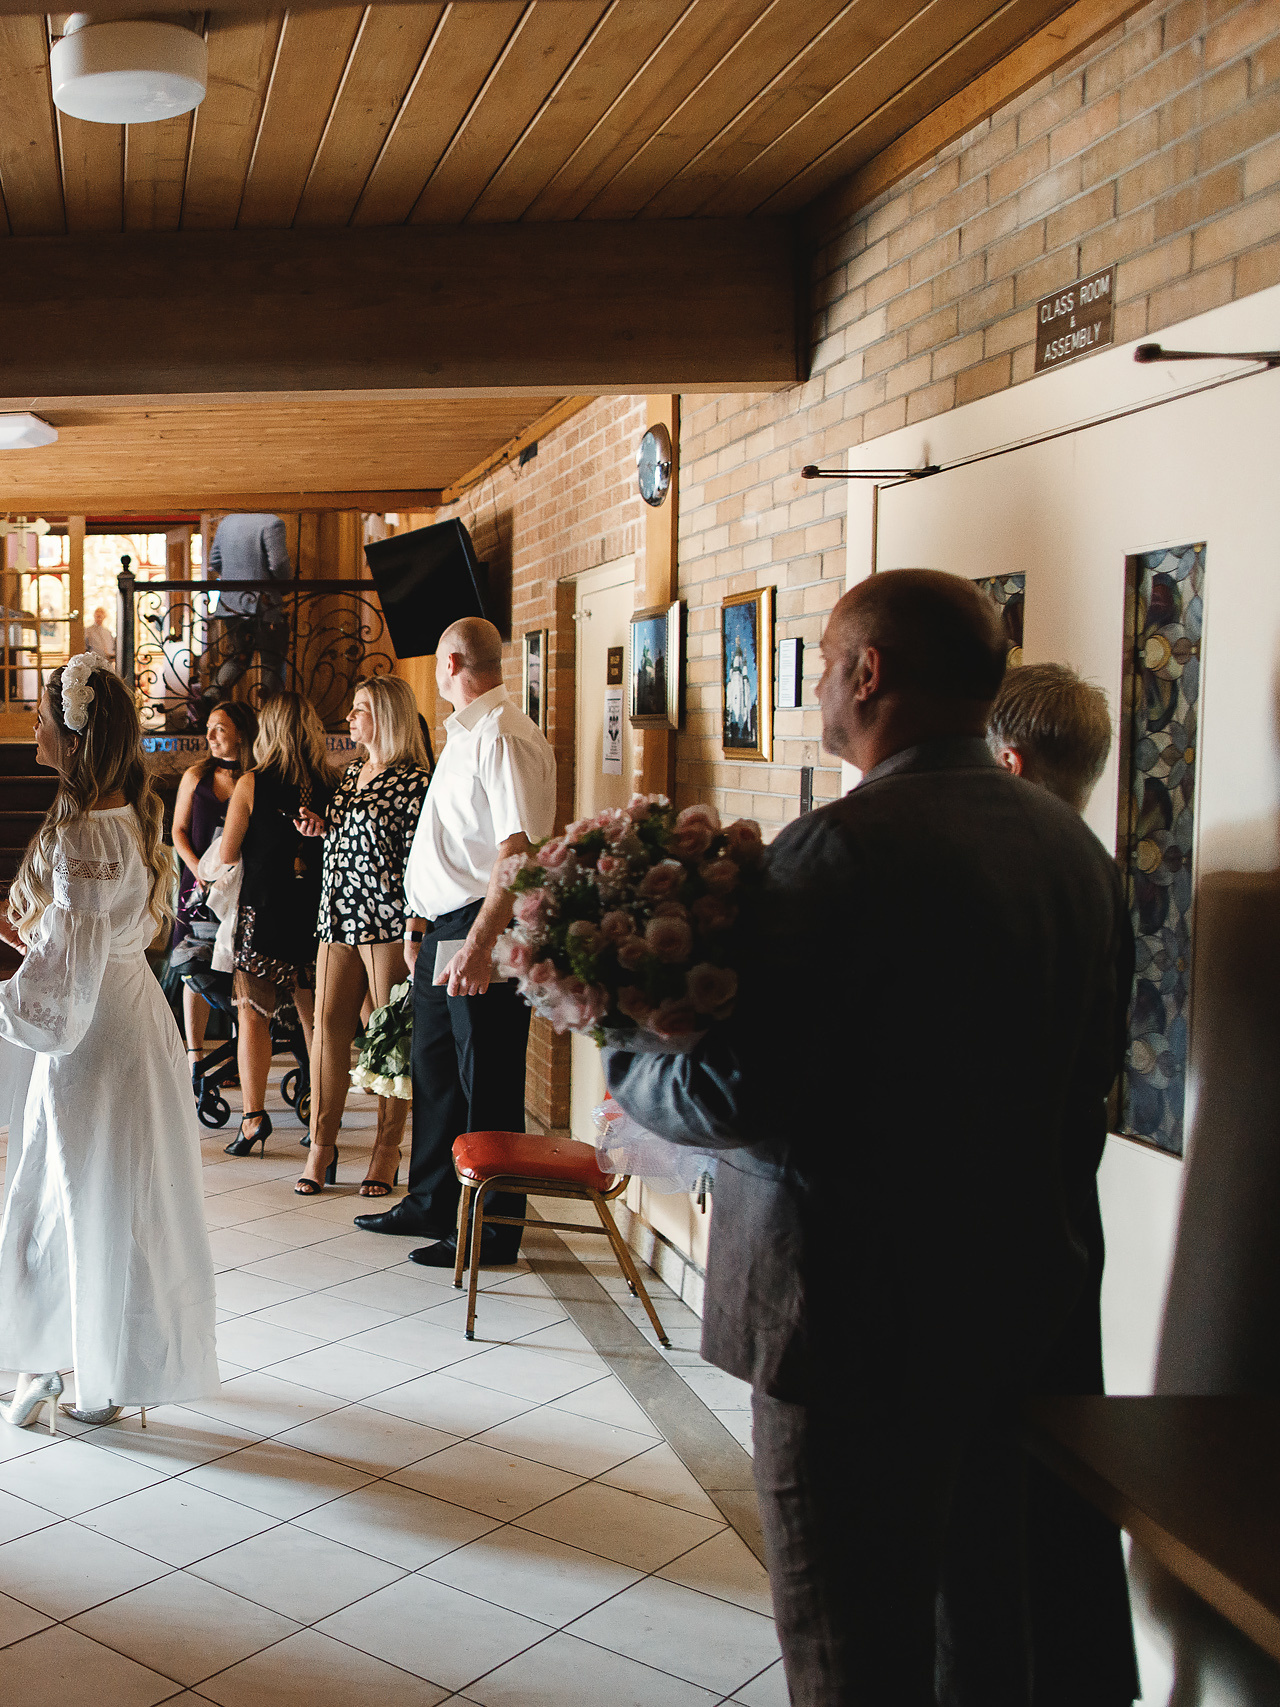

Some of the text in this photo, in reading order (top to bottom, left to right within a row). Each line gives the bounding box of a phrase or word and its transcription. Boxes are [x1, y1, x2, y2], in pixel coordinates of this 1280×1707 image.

[1040, 275, 1110, 324] CLASS ROOM
[1043, 321, 1102, 363] ASSEMBLY
